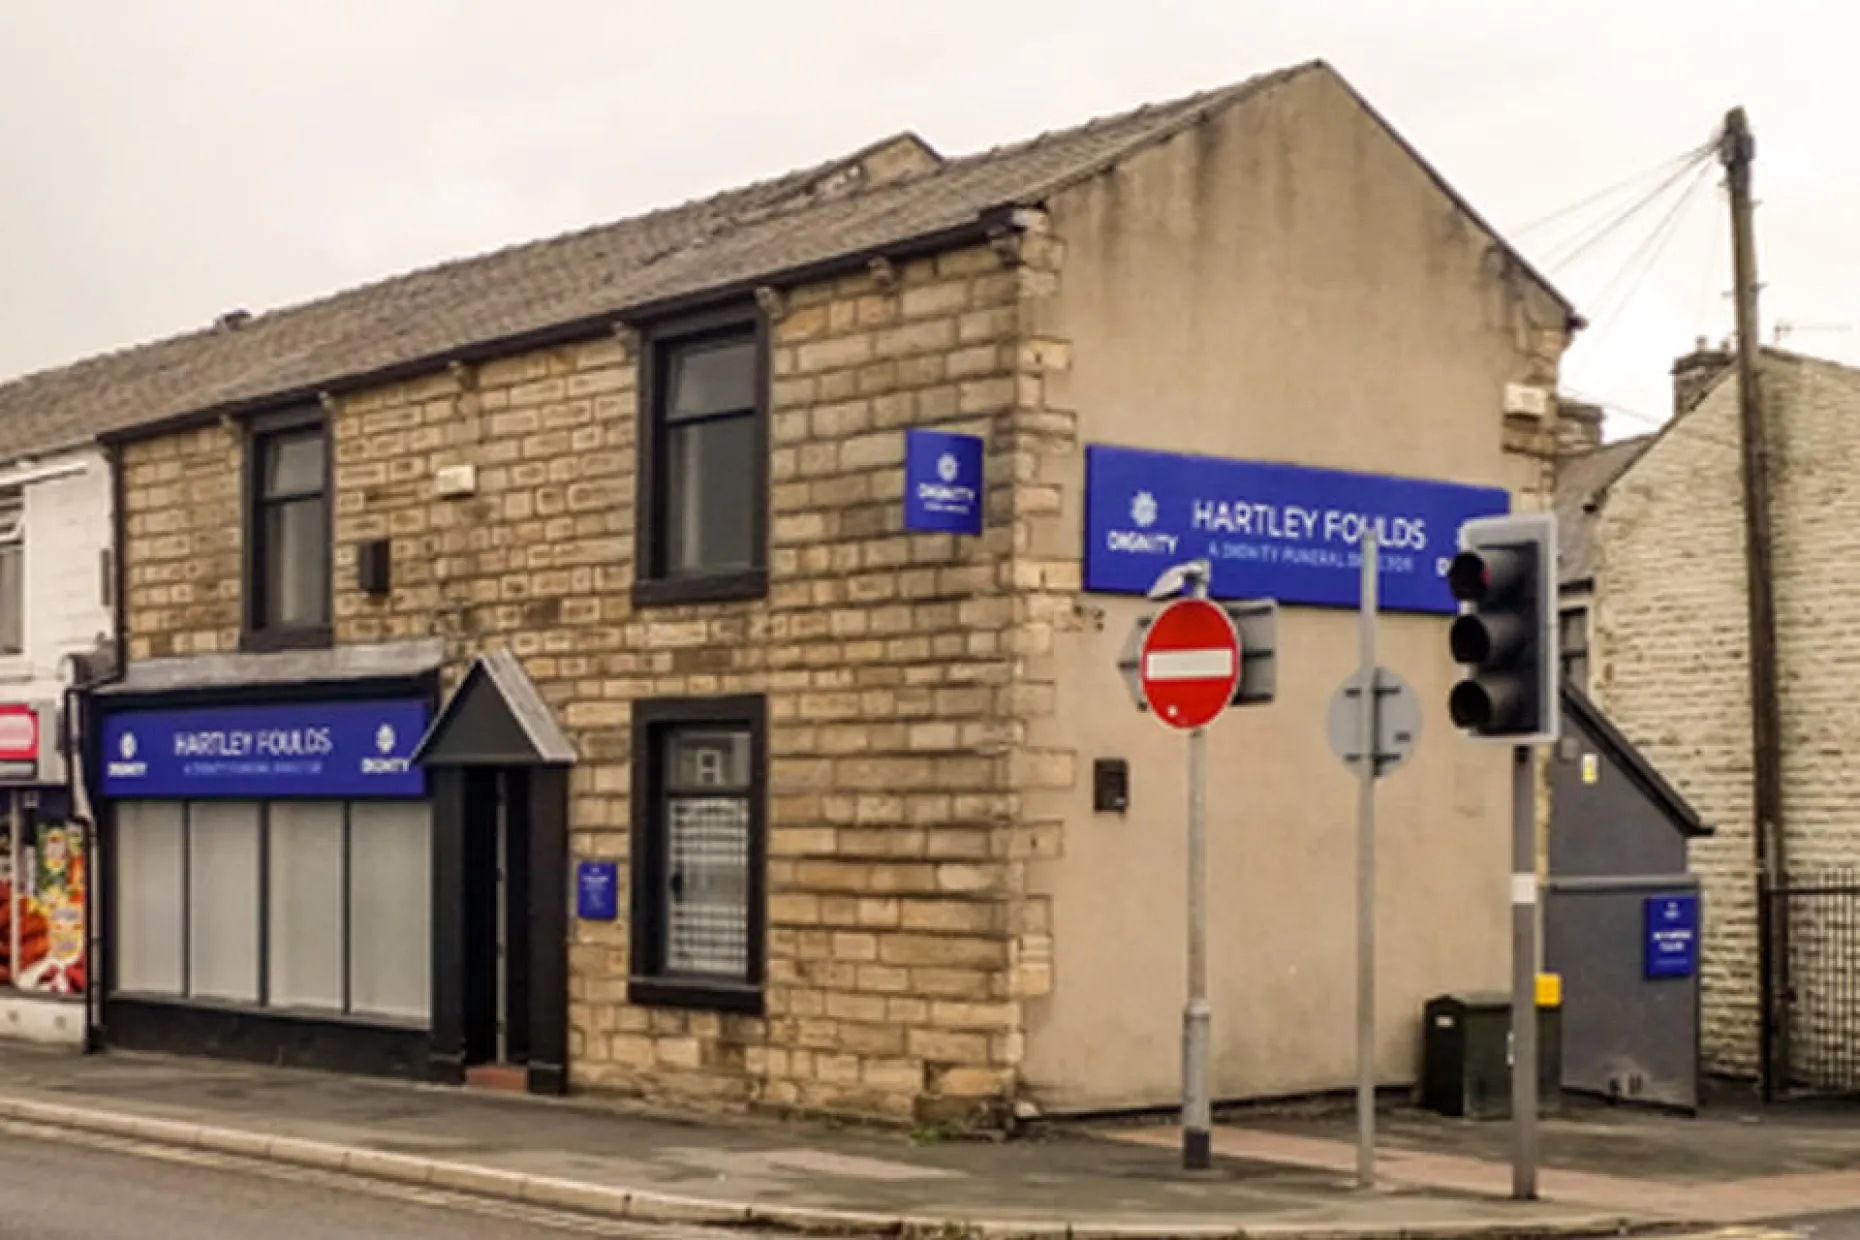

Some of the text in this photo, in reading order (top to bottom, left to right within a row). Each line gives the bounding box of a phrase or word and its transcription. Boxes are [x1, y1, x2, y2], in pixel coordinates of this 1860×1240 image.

[1192, 499, 1427, 550] HARTLEY FOULDS
[1106, 530, 1178, 556] DIGNITY
[174, 726, 333, 757] HARTLEY FOULDS
